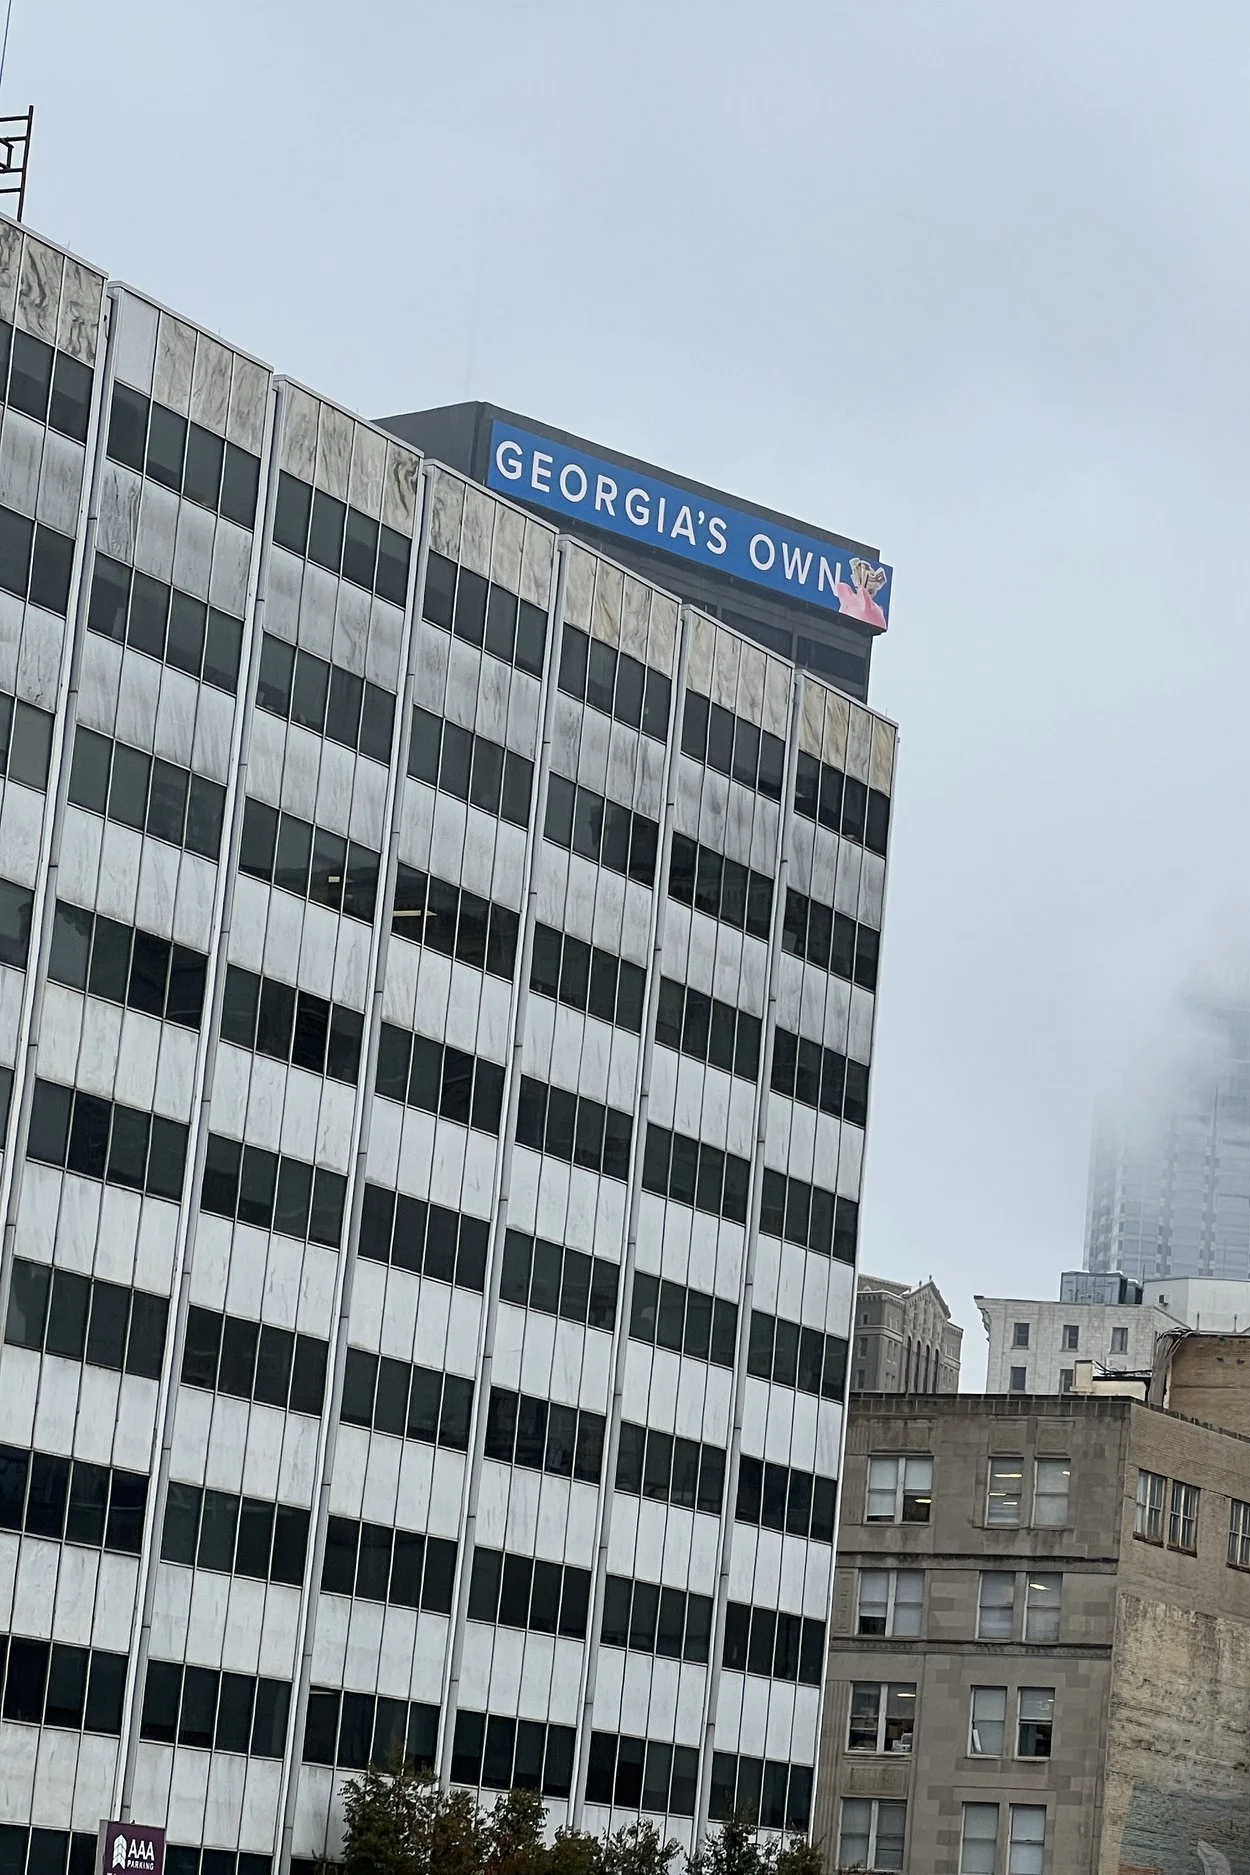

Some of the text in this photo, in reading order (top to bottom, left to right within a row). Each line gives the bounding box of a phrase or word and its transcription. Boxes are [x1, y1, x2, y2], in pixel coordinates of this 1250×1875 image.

[495, 440, 842, 597] GEORGIA'S OWN
[127, 1838, 155, 1861] AAA
[126, 1859, 154, 1871] PARKING
